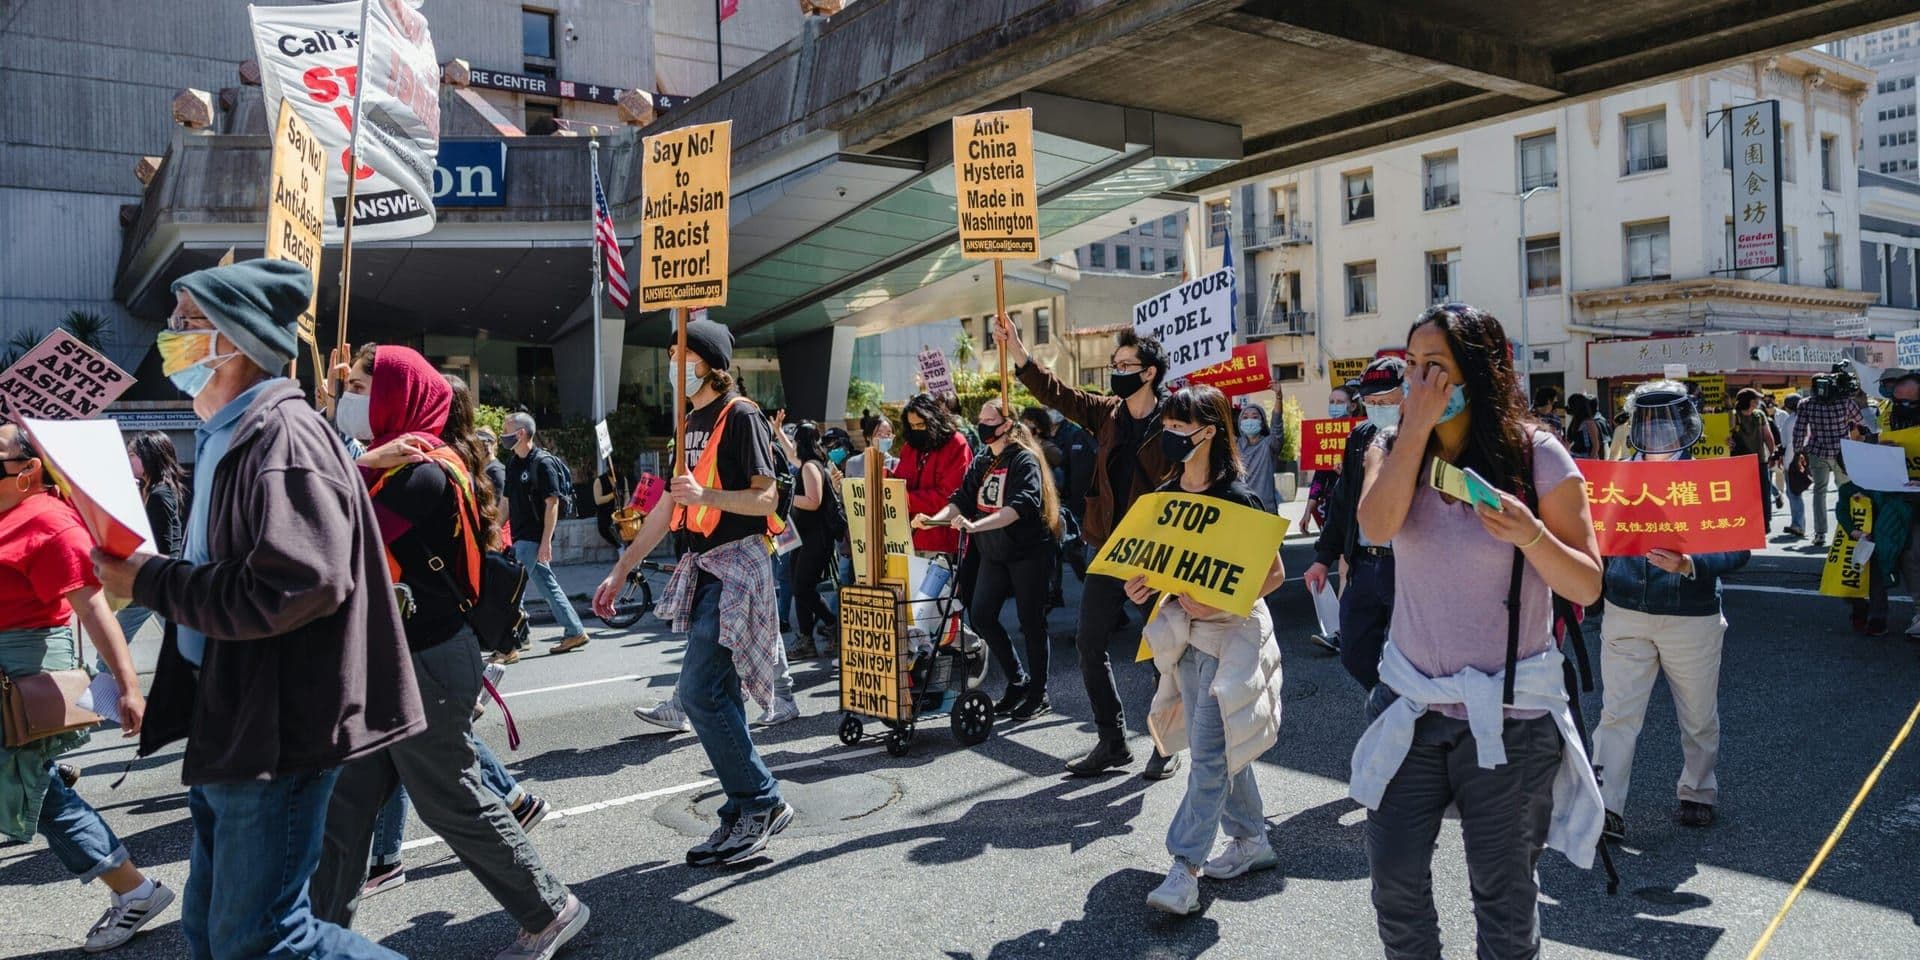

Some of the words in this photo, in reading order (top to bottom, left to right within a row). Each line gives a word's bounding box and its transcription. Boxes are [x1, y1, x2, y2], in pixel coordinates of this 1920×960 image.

[278, 30, 337, 57] Call
[493, 74, 547, 92] CENTER
[973, 116, 1010, 137] Anti-
[287, 116, 308, 162] Say
[308, 141, 321, 176] No!
[652, 140, 683, 167] Say
[688, 129, 715, 158] No!
[968, 139, 1017, 160] China
[675, 169, 690, 187] to
[963, 160, 1024, 184] Hysteria
[1741, 111, 1768, 225] 花園食坊
[300, 172, 309, 193] to
[275, 176, 322, 242] Anti-Asian
[644, 188, 724, 220] Anti-Asian
[967, 189, 1007, 209] Made
[1011, 188, 1025, 207] in
[654, 219, 710, 250] Racist
[961, 211, 1033, 235] Washington
[283, 220, 313, 271] Racist
[965, 239, 1034, 251] ANSWERCoalition.org
[1738, 232, 1774, 243] Garden
[652, 249, 710, 280] Terror!
[644, 284, 721, 301] ANSWERCoalition.org
[1136, 293, 1172, 325] NOT
[1179, 270, 1230, 306] YOUR
[55, 339, 122, 384] STOP
[1333, 360, 1345, 369] Say
[1346, 360, 1356, 368] NO
[1356, 360, 1363, 368] to
[1771, 345, 1801, 361] Garden
[1803, 346, 1843, 363] Restauran
[37, 354, 105, 397] ANTI-
[924, 367, 946, 380] STOP
[0, 377, 80, 420] ATTACK
[15, 364, 99, 416] ASIAN
[852, 483, 865, 499] Joi
[1157, 499, 1221, 534] STOP
[1700, 516, 1747, 530] 抗暴力
[1828, 528, 1846, 564] STOP
[1104, 537, 1174, 574] ASIAN
[1173, 549, 1245, 596] HATE
[843, 607, 896, 631] VIOLENCE
[848, 629, 891, 652] RACIST
[845, 650, 893, 673] AGAINST
[855, 670, 881, 691] NOW
[849, 688, 888, 713] UNITE
